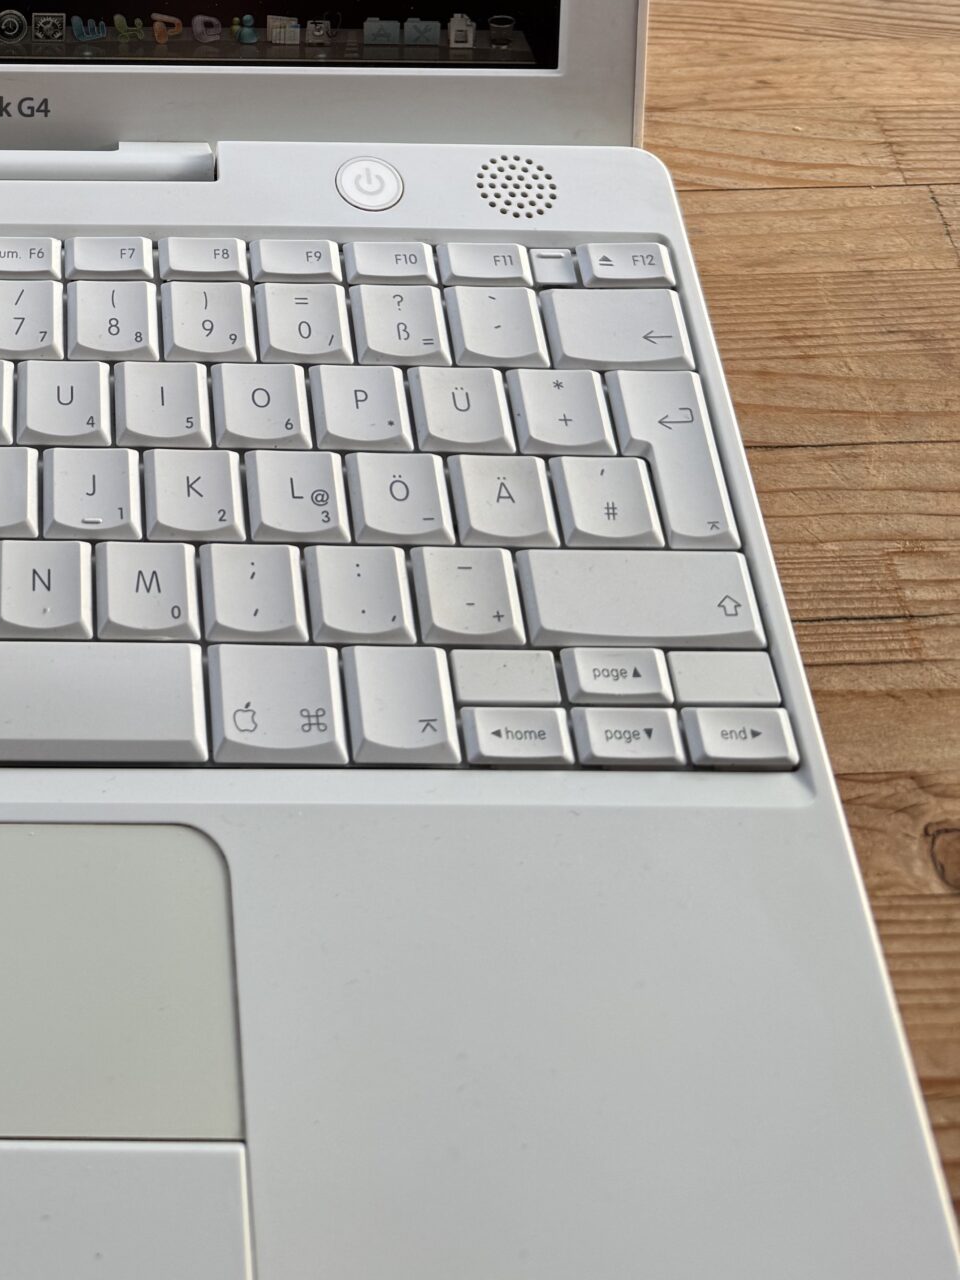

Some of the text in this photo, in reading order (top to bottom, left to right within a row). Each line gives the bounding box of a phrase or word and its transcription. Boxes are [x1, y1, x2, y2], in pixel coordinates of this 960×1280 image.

[17, 97, 51, 118] G4
[29, 247, 45, 260] F6
[119, 247, 136, 259] F7
[213, 247, 230, 260] F8
[305, 250, 323, 263] F9
[394, 252, 418, 266] F10
[493, 254, 514, 267] F11
[632, 254, 656, 267] F12
[57, 386, 74, 406] U
[159, 386, 166, 407] I
[251, 387, 272, 409] O
[354, 389, 369, 410] P
[452, 386, 472, 413] Ü
[85, 474, 97, 497] J
[186, 475, 204, 498] K
[290, 477, 305, 500] L
[388, 474, 411, 502] Ö
[495, 475, 516, 505] Ä
[592, 665, 629, 682] page
[505, 726, 547, 742] home
[603, 726, 640, 743] page
[720, 726, 748, 742] end
